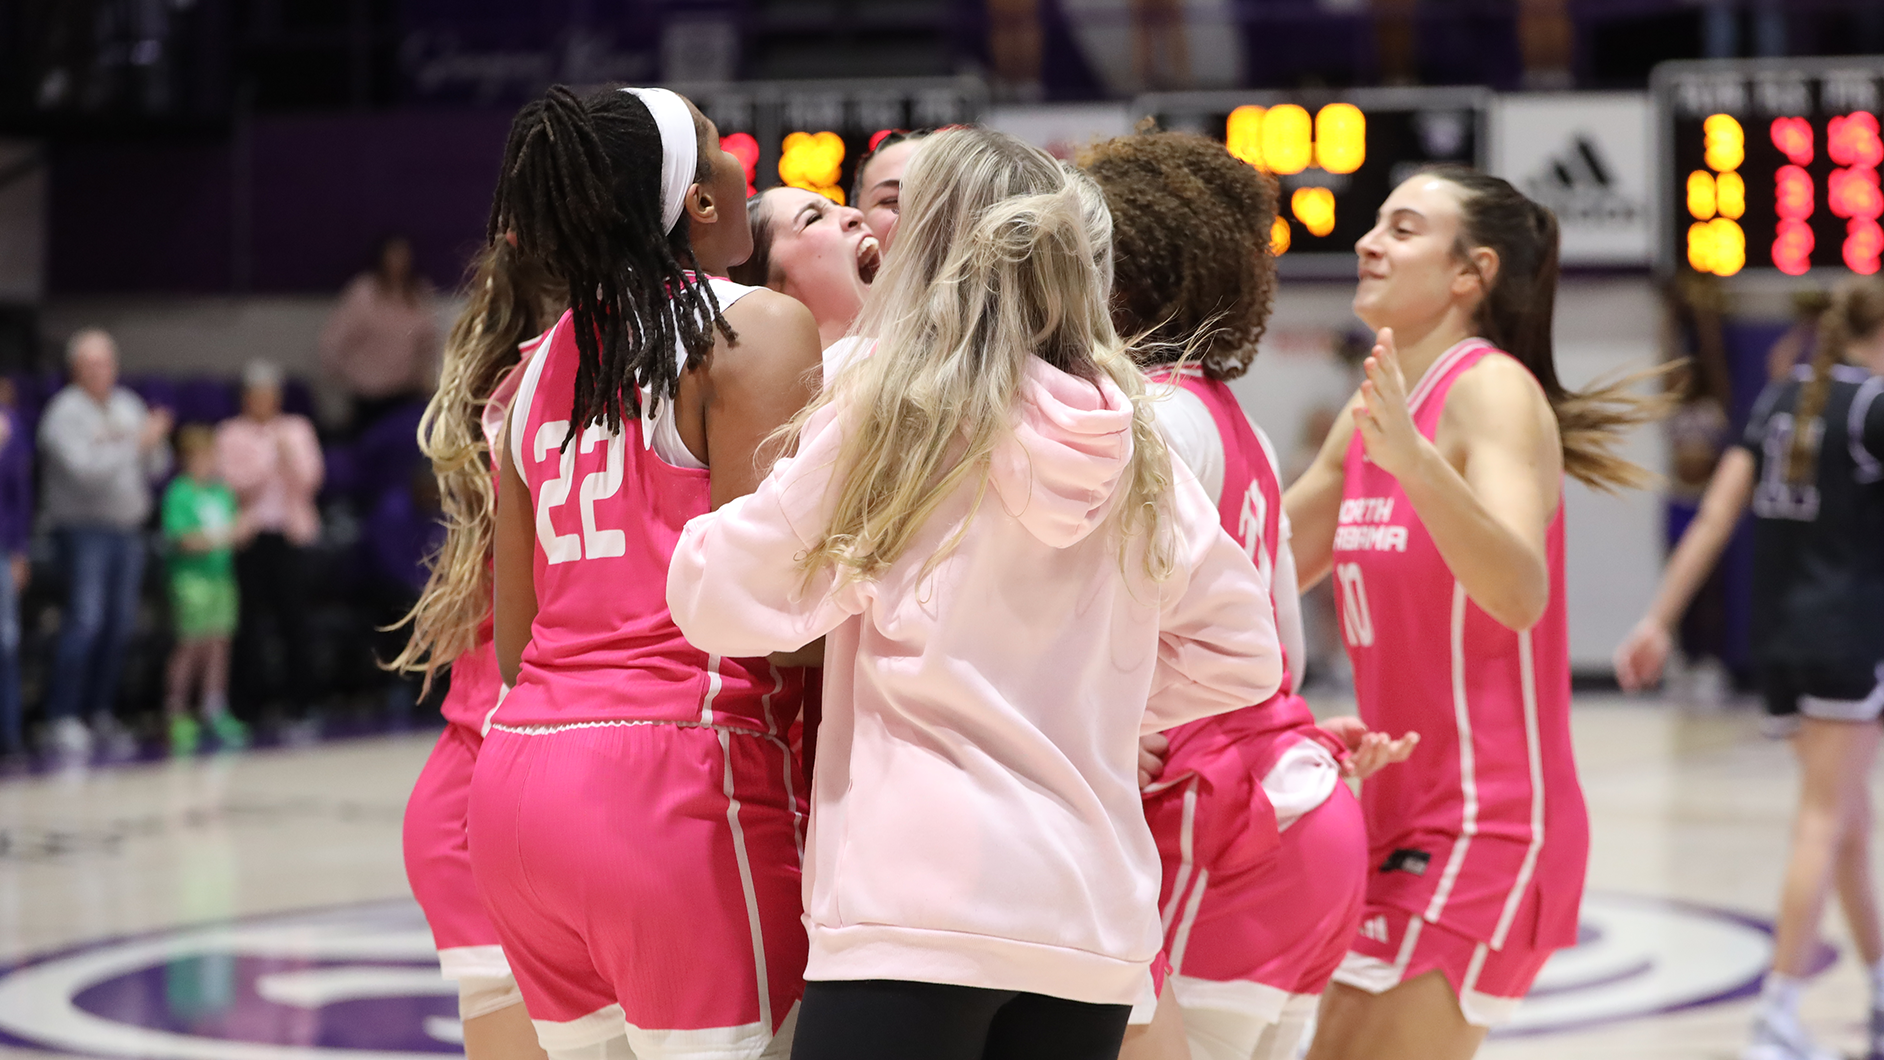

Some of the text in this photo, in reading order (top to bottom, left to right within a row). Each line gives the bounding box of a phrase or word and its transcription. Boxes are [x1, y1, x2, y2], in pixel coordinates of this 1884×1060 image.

[534, 412, 626, 565] 22
[1339, 496, 1395, 524] ORTH
[1333, 525, 1409, 553] ABAMA
[1337, 562, 1375, 647] 10
